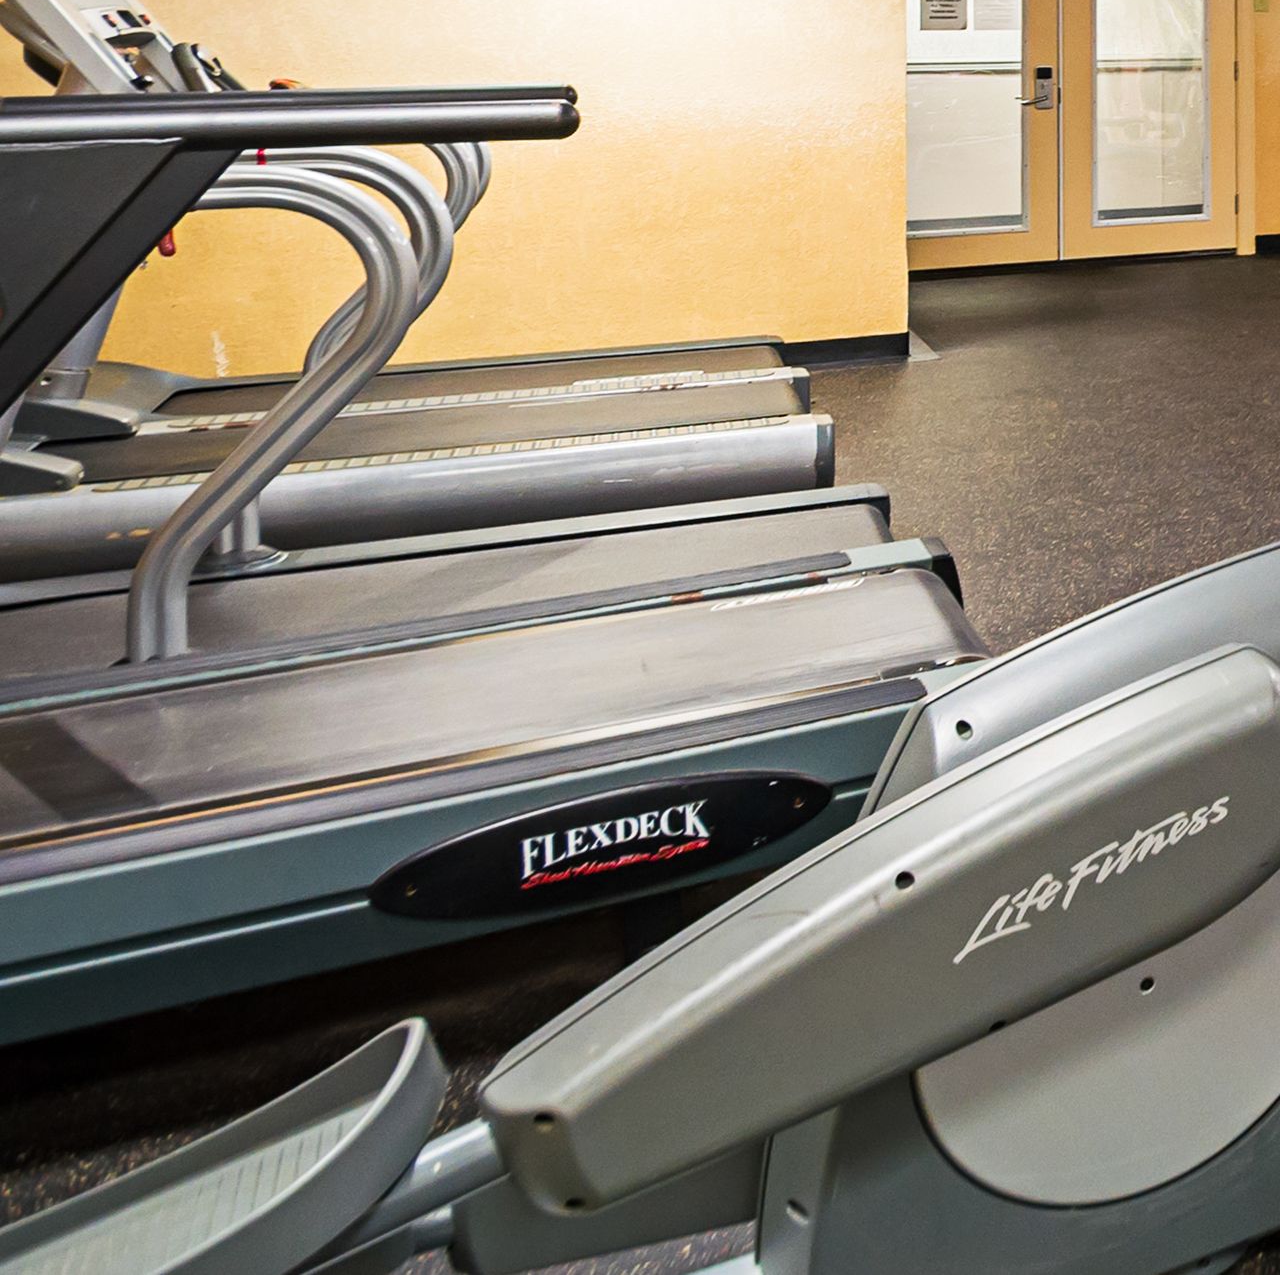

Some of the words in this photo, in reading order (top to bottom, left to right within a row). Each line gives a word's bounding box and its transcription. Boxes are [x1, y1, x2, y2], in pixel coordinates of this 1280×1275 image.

[520, 798, 710, 880] FLEXDECK
[952, 873, 1063, 964] Life
[1063, 796, 1230, 910] Fitness
